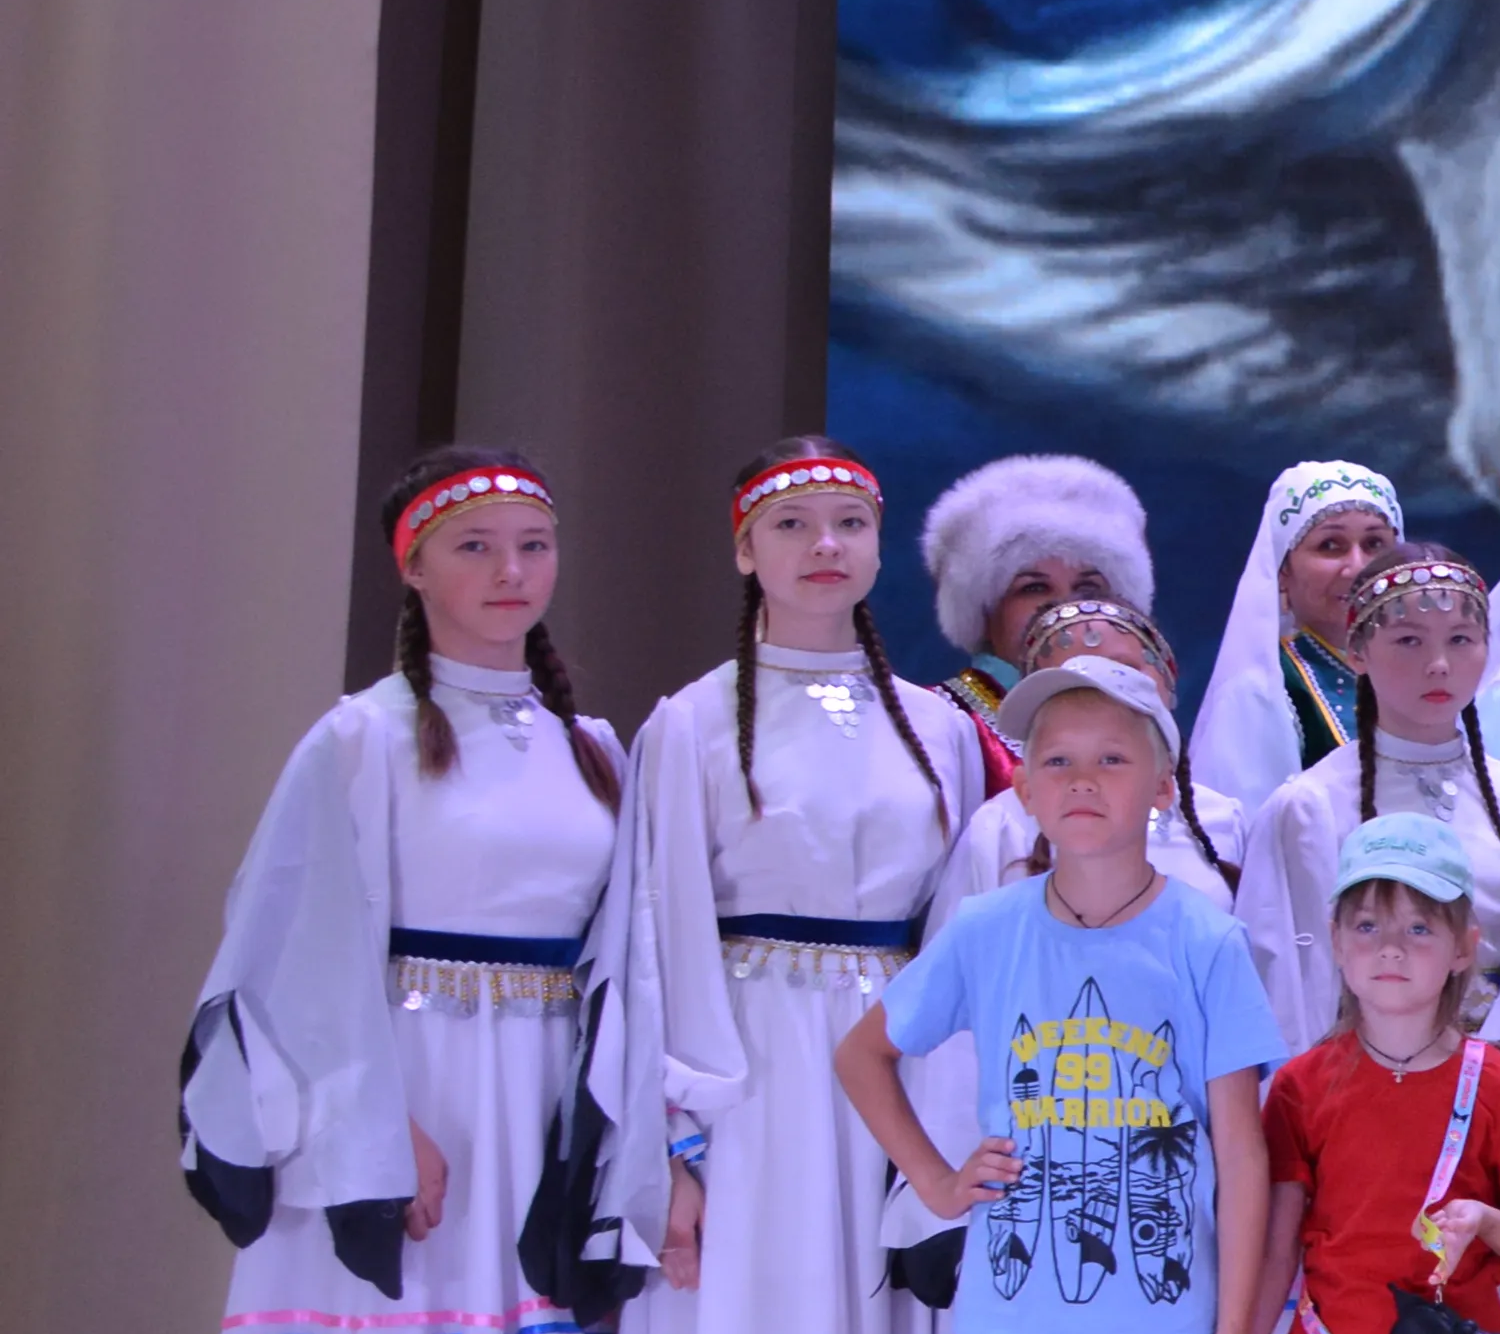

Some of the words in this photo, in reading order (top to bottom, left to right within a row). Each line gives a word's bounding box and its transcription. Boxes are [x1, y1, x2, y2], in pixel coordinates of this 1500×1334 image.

[1011, 1018, 1170, 1067] WEEKEND
[1055, 1053, 1111, 1091] 99
[1011, 1095, 1172, 1129] WARRIOR
